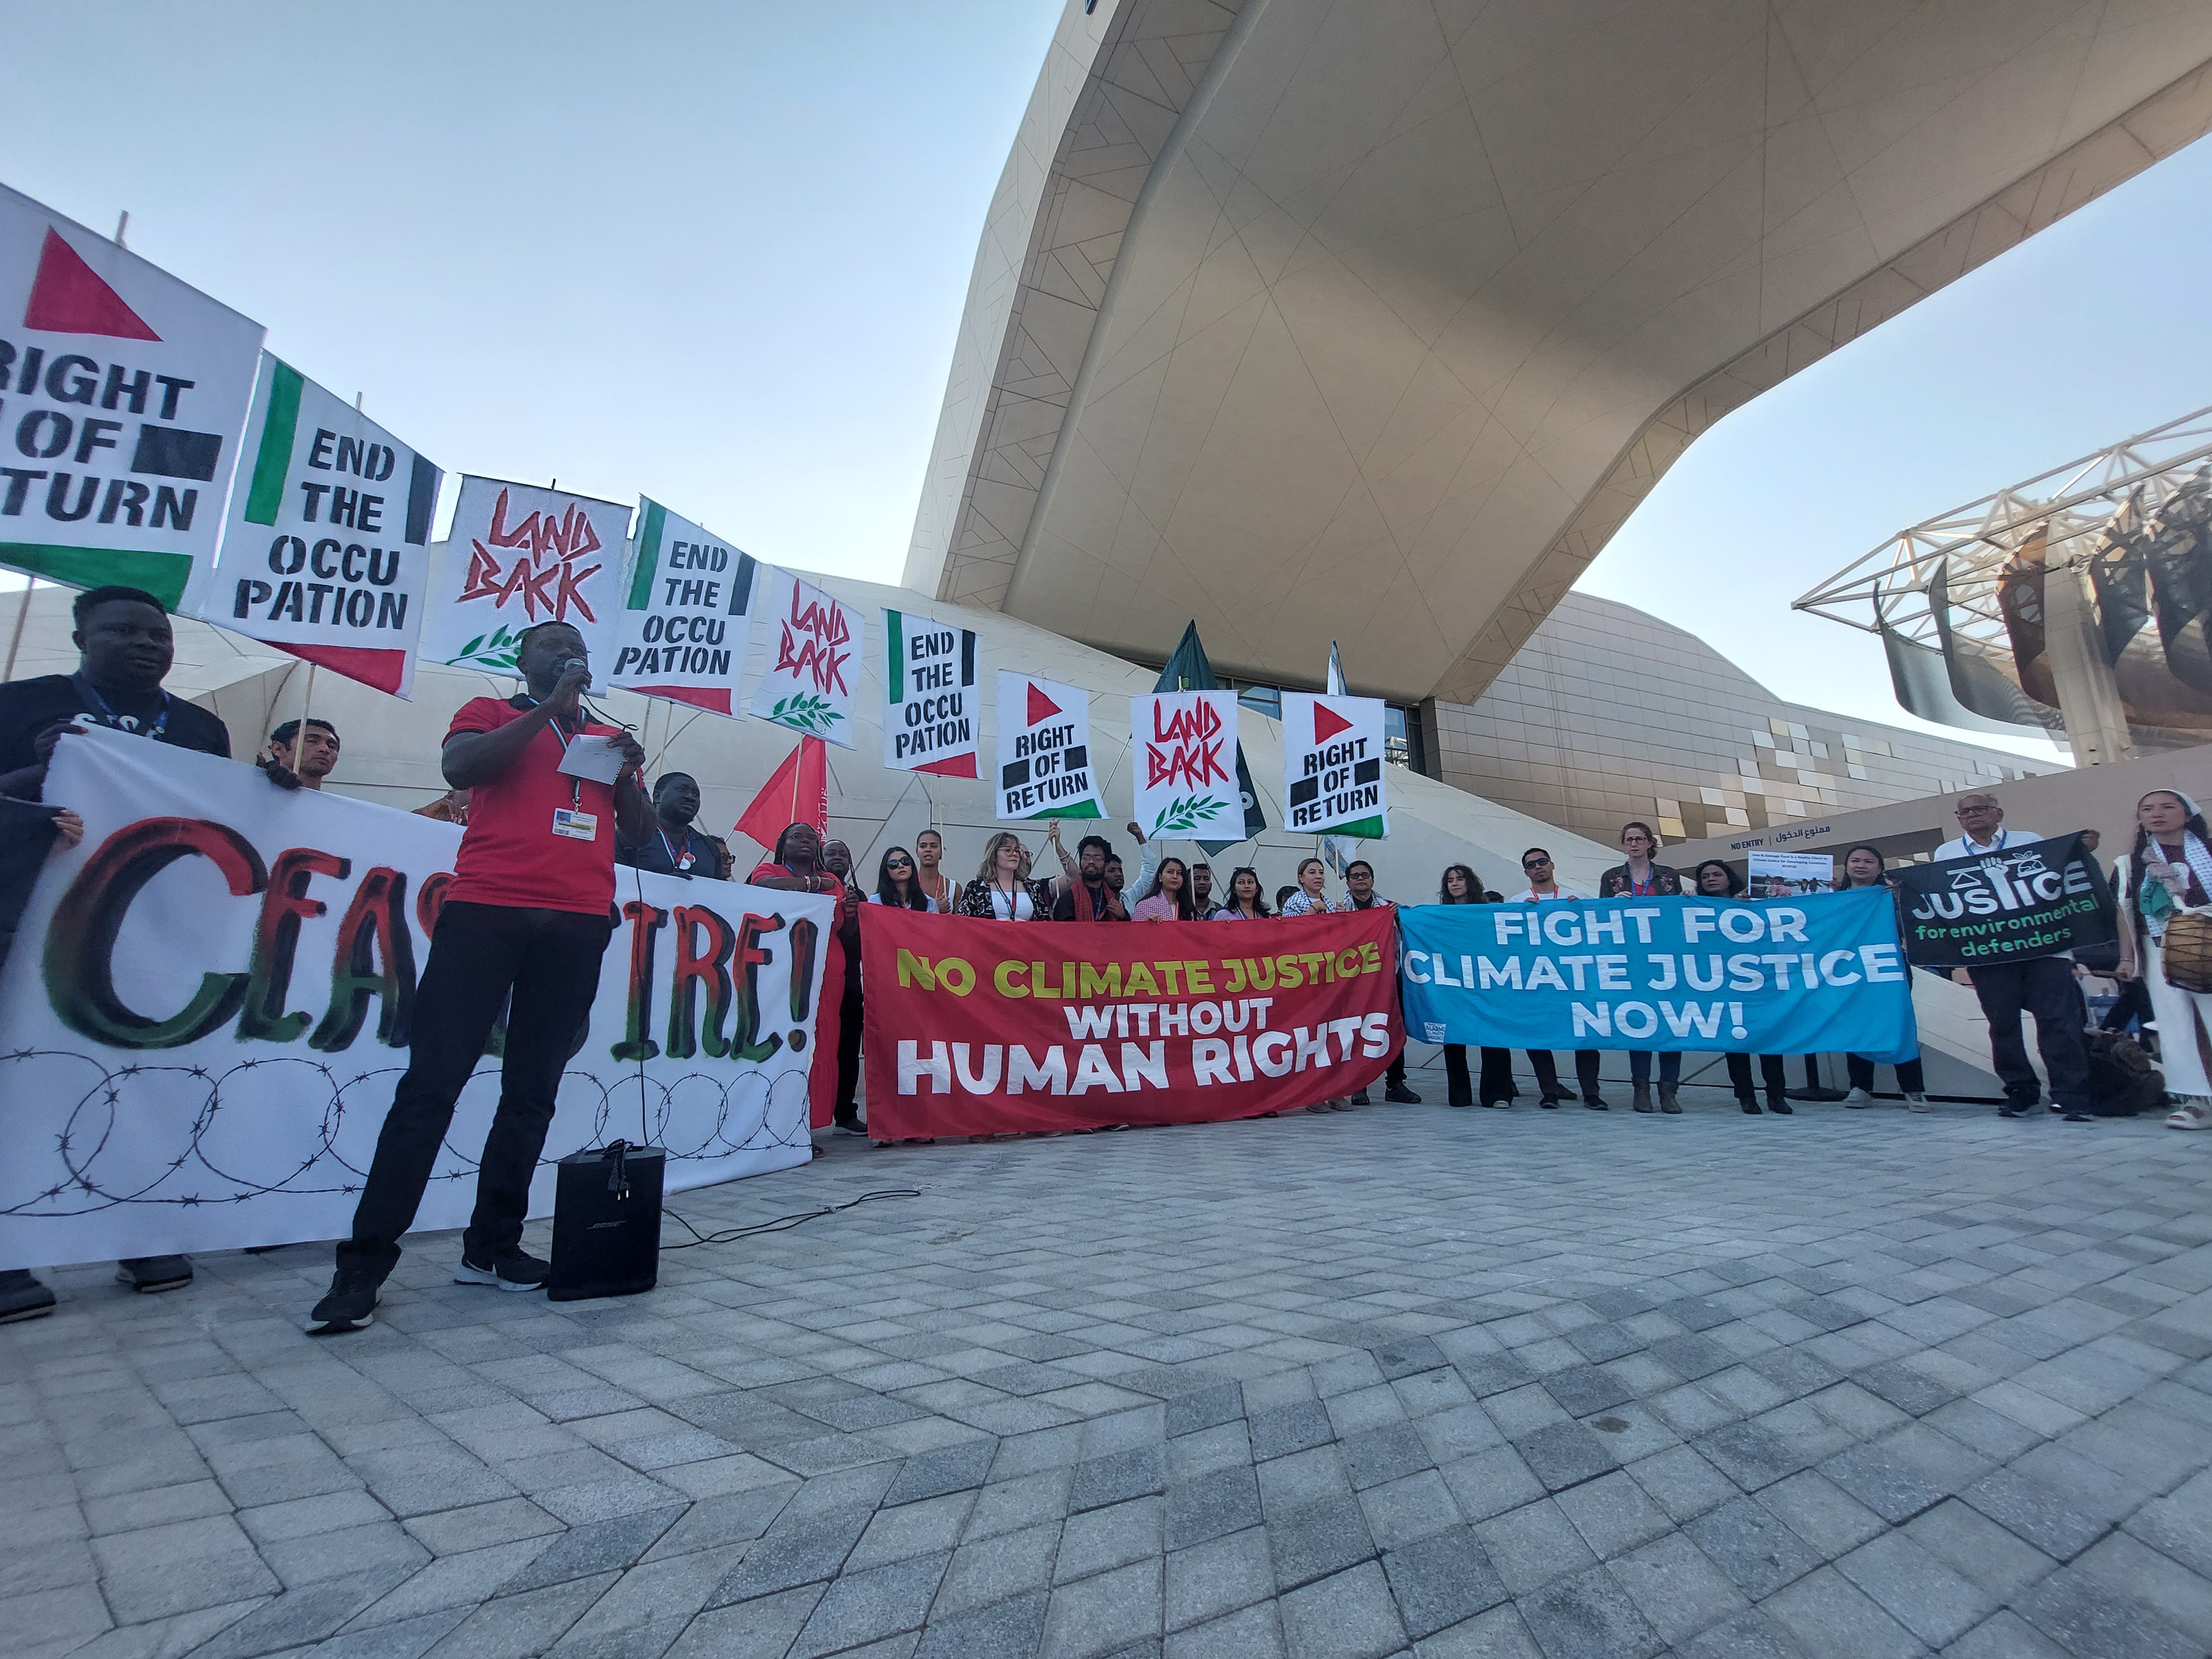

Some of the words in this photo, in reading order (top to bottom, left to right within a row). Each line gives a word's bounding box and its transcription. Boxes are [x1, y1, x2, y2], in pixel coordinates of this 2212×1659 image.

[15, 410, 123, 465] OF
[308, 427, 396, 482] END
[301, 481, 385, 533] THE
[489, 487, 601, 568] LAND
[268, 534, 400, 586] OCCU
[669, 541, 728, 573] END
[233, 579, 408, 631] PATION
[665, 578, 720, 608] THE
[791, 578, 849, 647] LAND
[643, 615, 725, 645] OCCU
[911, 631, 954, 660] END
[613, 646, 731, 675] PATION
[911, 662, 953, 692] THE
[905, 693, 962, 727] OCCU
[1154, 696, 1222, 752] LAND
[895, 718, 971, 759] PATION
[1016, 724, 1075, 758] RIGHT
[1304, 737, 1368, 776] RIGHT
[1035, 752, 1060, 779] OF
[1323, 766, 1349, 793] OF
[1006, 771, 1088, 814] RETURN
[1293, 784, 1378, 827] RETURN
[1742, 838, 1764, 848] ENTRY
[1776, 829, 1803, 842] الدخول
[1805, 826, 1830, 839] ممنوع
[1912, 857, 2093, 920] JUSTICE
[1494, 907, 1660, 946] FIGHT
[1682, 907, 1809, 943] FOR
[1915, 924, 1947, 940] for
[1949, 893, 2100, 938] environmental
[41, 816, 818, 1063] CEAIRE!
[1961, 927, 2072, 957] defenders
[897, 948, 975, 997] NO
[994, 959, 1215, 999] CLIMATE
[1222, 941, 1382, 993] JUSTICE
[1403, 949, 1632, 991] CLIMATE
[1647, 943, 1905, 991] JUSTICE
[1063, 997, 1273, 1040] WITHOUT
[1571, 1001, 1748, 1040] NOW!
[898, 1039, 1168, 1095] HUMAN
[1192, 1012, 1390, 1087] RIGHTS
